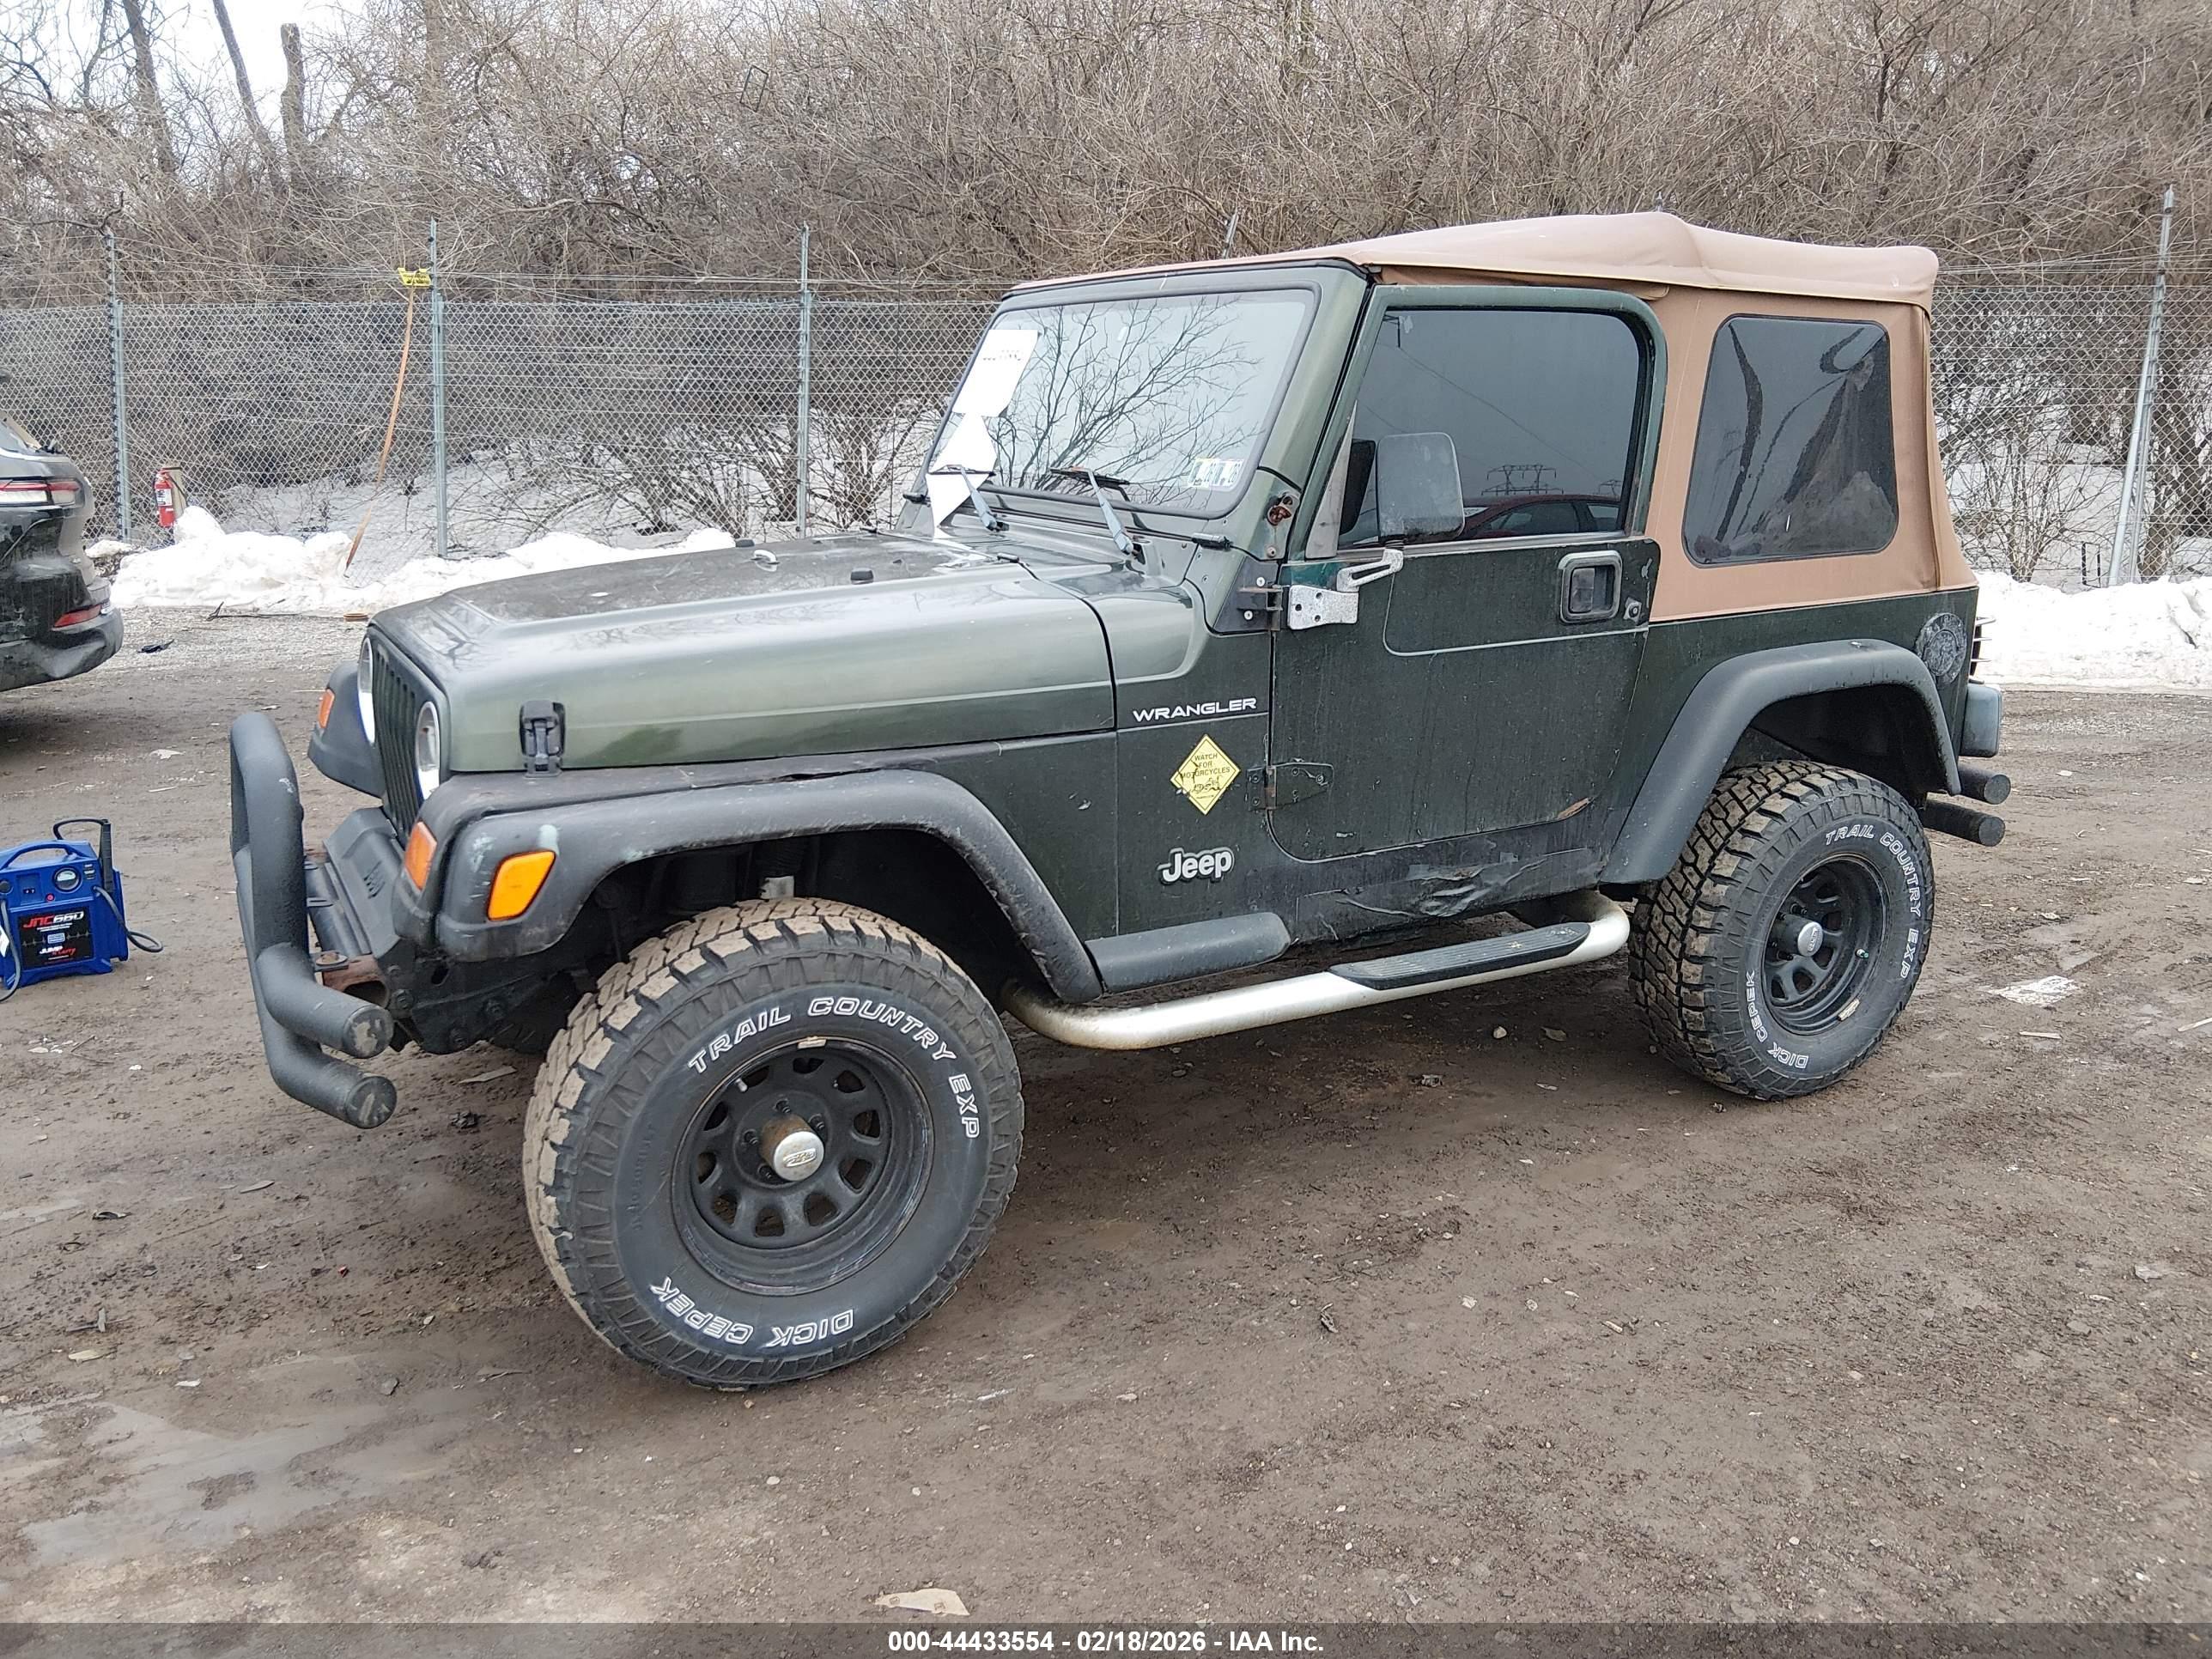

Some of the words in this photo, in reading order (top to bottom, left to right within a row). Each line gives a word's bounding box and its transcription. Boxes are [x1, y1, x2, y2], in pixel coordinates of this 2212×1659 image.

[1133, 697, 1257, 722] WRANGLER
[1826, 824, 1875, 845] TRAIL
[1159, 848, 1233, 884] Jeep
[1880, 832, 1922, 917] COUNTRY
[1900, 928, 1919, 979] EXP
[1745, 971, 1768, 1042] CEPEK
[688, 1006, 792, 1074] TRAIL
[808, 997, 957, 1062] COUNTRY
[949, 1073, 981, 1139] EXP
[1767, 1042, 1808, 1069] DICK
[650, 1276, 754, 1345] CEPEK
[765, 1309, 854, 1346] DICK
